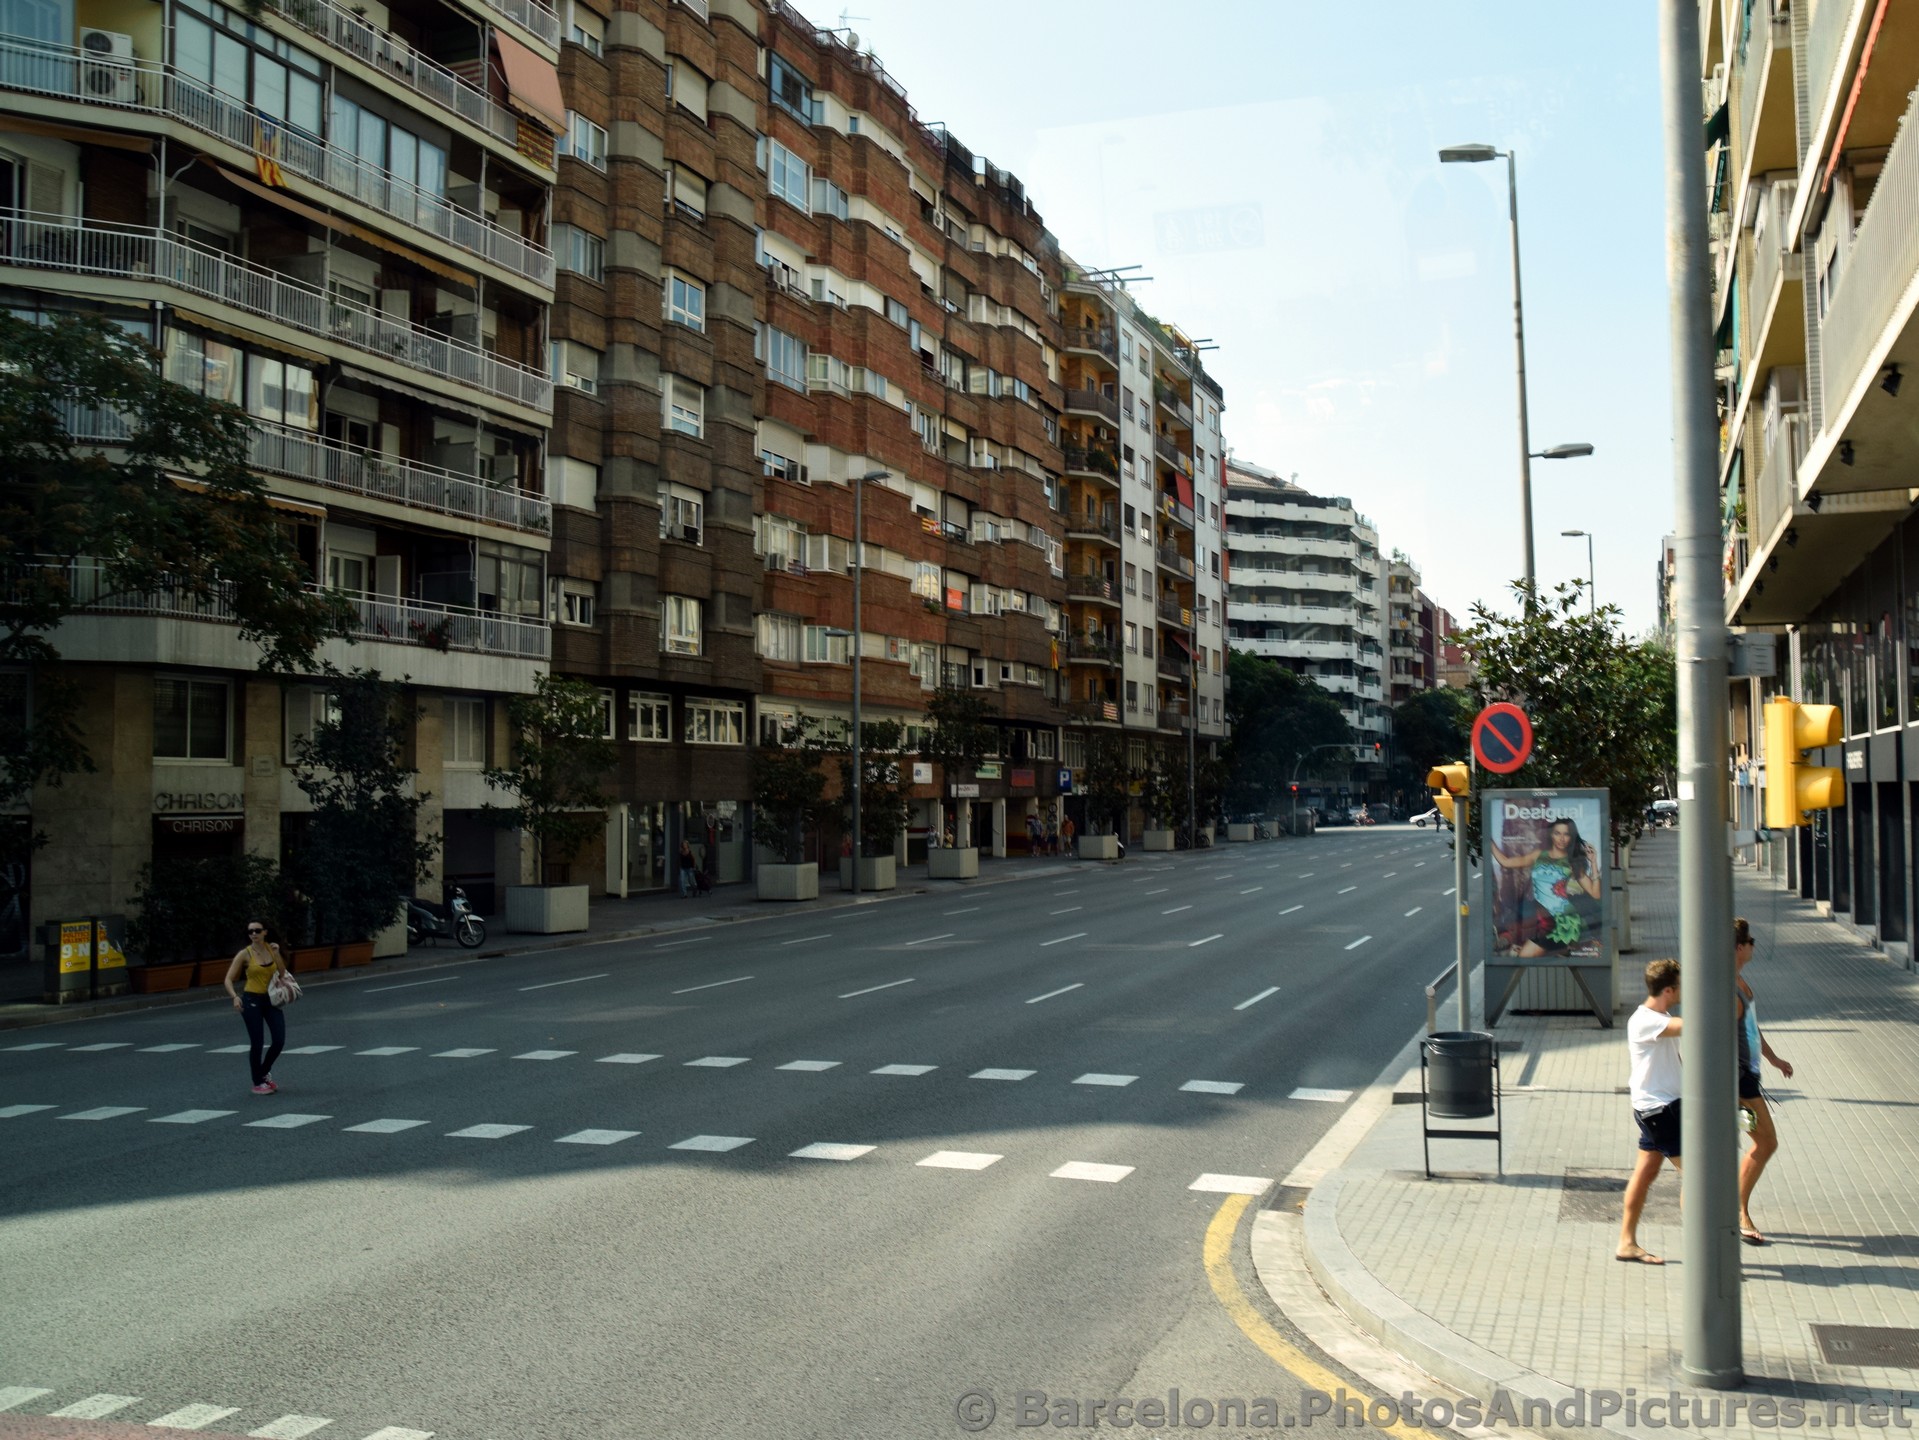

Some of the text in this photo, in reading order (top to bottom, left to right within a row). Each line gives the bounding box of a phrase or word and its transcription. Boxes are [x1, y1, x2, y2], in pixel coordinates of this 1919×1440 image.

[1060, 771, 1070, 786] P
[155, 792, 244, 811] CHRISON
[1504, 803, 1583, 823] Desigual
[173, 820, 234, 832] CHRISON
